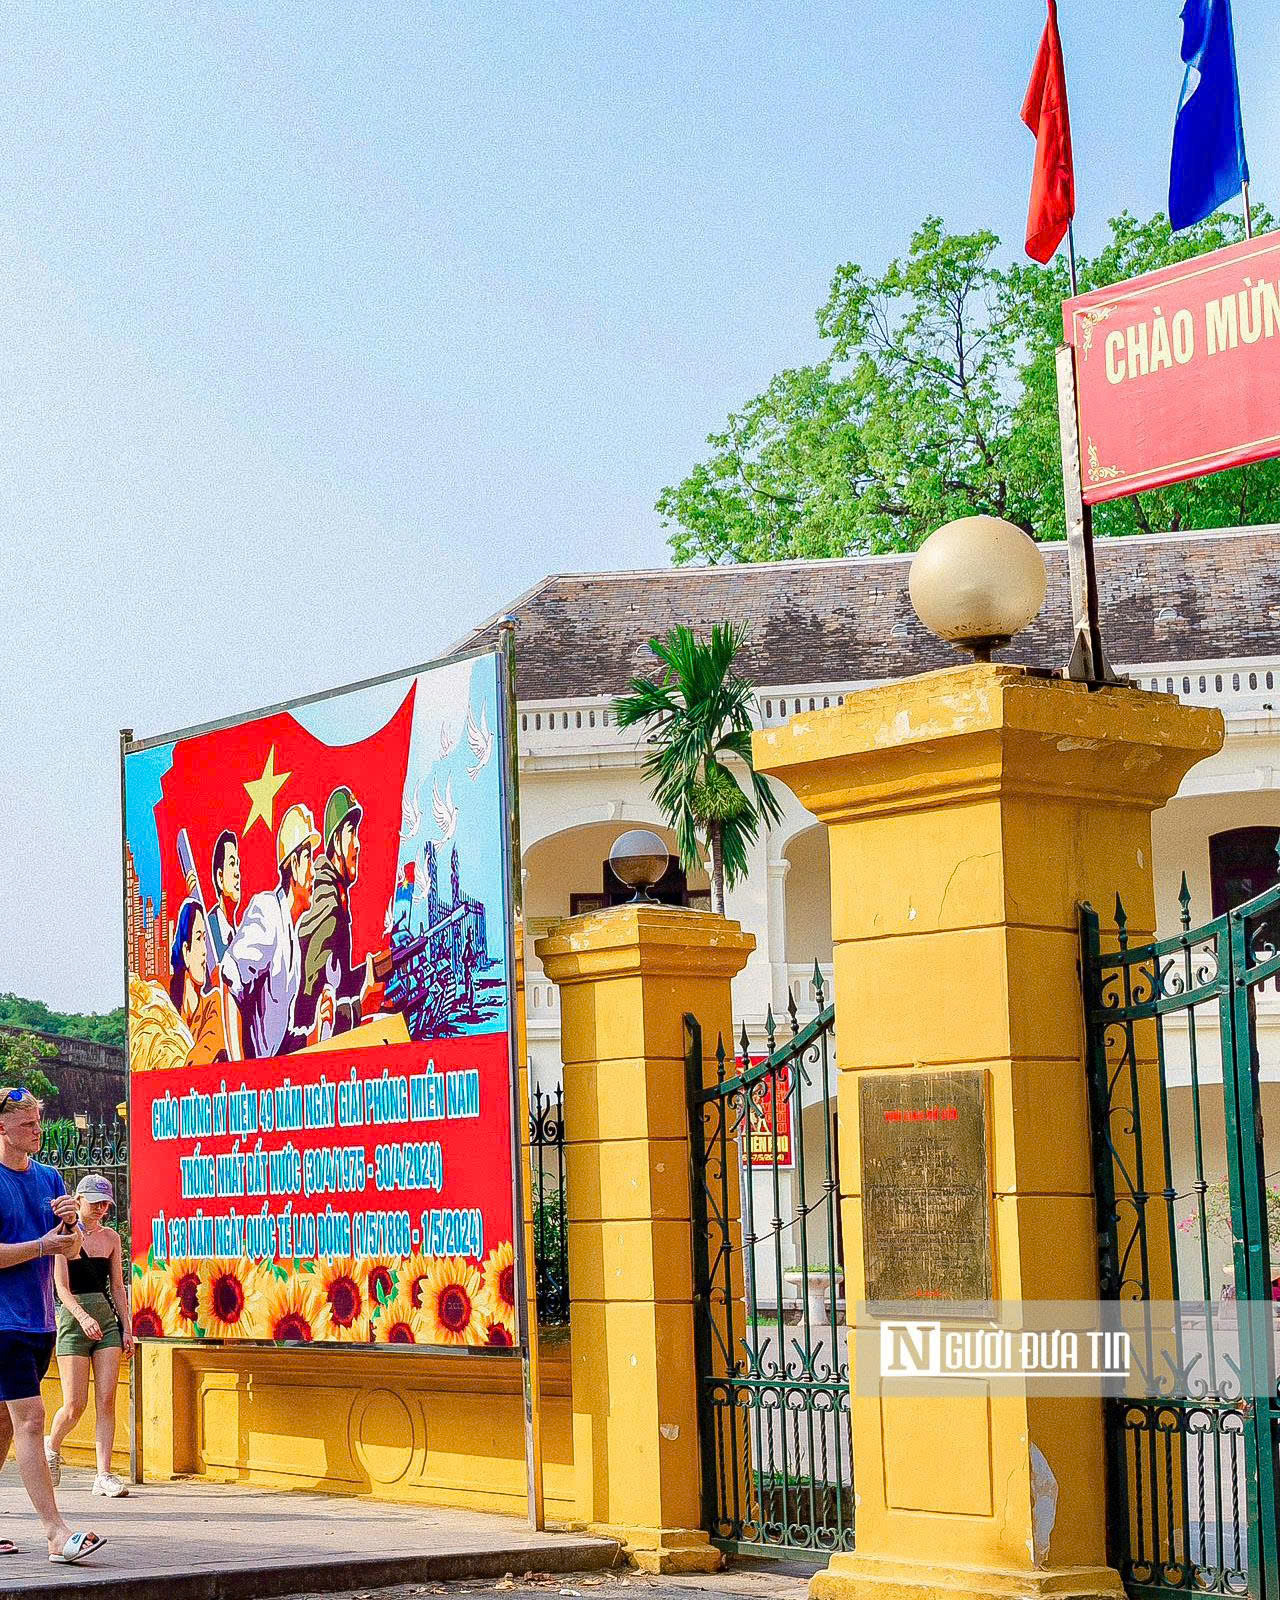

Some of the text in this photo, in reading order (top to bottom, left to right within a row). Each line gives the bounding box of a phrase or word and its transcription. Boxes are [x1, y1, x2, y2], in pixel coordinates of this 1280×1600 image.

[1104, 306, 1195, 385] CHÀO
[152, 1059, 479, 1142] CHÀO MỪNG KỶ NIỆM 49 NĂM NGÀY GIẢI PHÓNG MIỀN NAM
[180, 1142, 214, 1198] THỐNG
[216, 1139, 246, 1197] NHẤT
[246, 1138, 268, 1196] ĐẤT
[269, 1142, 301, 1195] NƯỚC
[303, 1146, 365, 1198] (30/4/1975
[375, 1141, 442, 1193] 30/4/2024)
[152, 1210, 167, 1259] VÀ
[168, 1217, 187, 1259] 138
[188, 1208, 214, 1258] NĂM
[214, 1207, 245, 1258] NGÀY
[245, 1200, 276, 1263] QUỐC
[277, 1201, 293, 1258] TẾ
[293, 1213, 316, 1258] LAO
[316, 1203, 351, 1267] ĐỘNG
[353, 1210, 411, 1261] (1/5/1886
[421, 1208, 483, 1262] 1/5/2024)
